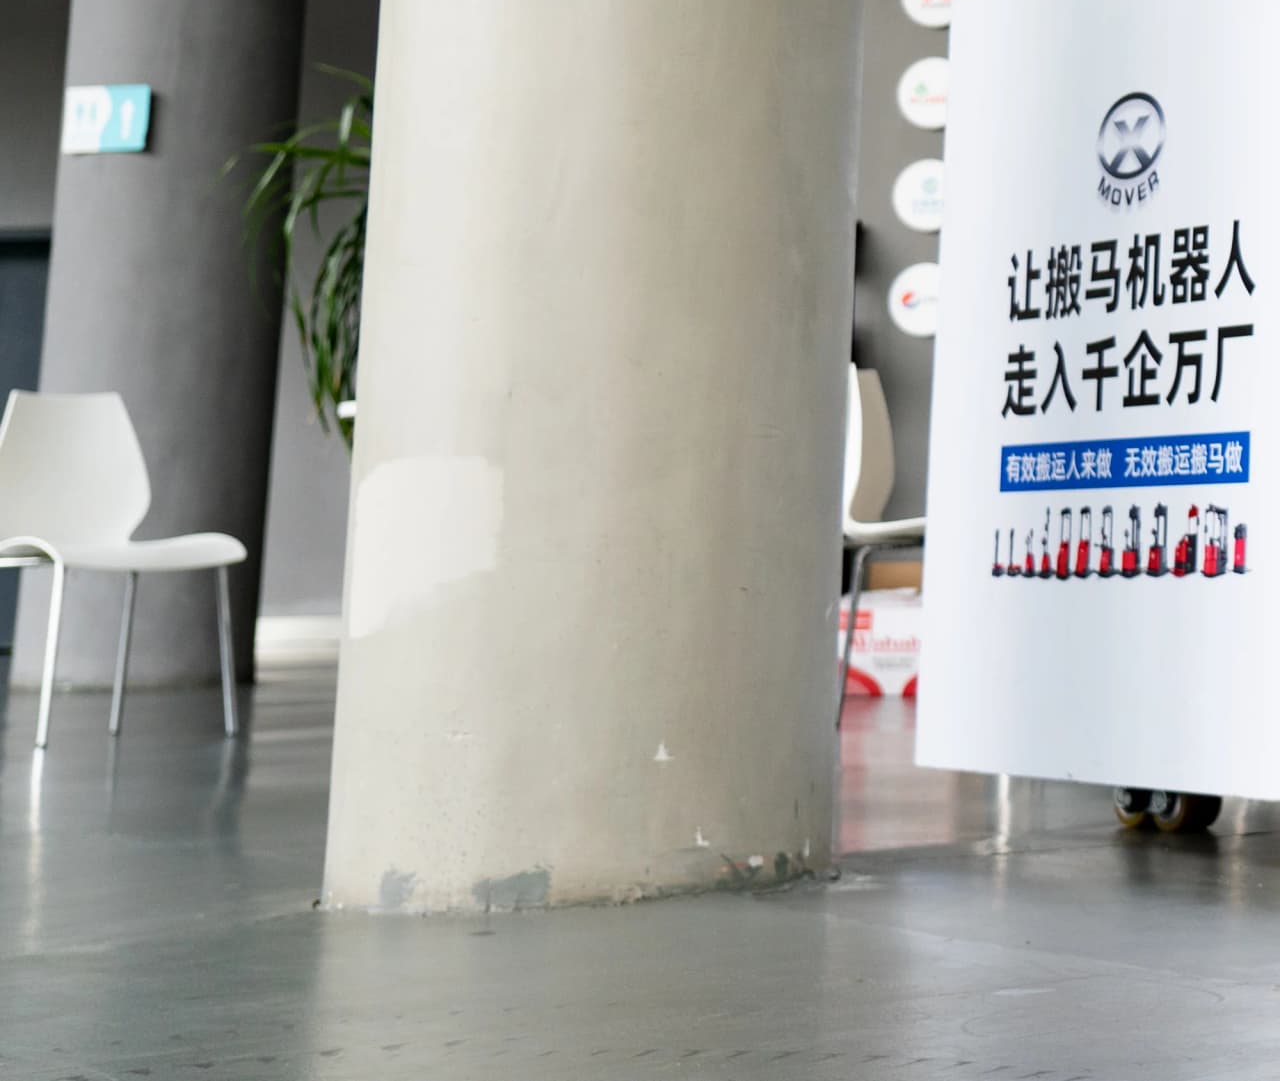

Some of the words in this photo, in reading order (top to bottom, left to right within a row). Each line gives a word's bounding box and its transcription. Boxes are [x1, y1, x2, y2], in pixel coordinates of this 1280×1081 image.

[1097, 170, 1160, 207] MOVER
[1008, 219, 1256, 322] 让搬马机器人
[1001, 323, 1255, 419] 走入千企万厂
[1006, 447, 1113, 483] 有效搬运人来做
[1124, 440, 1243, 478] 无效搬运搬马做
